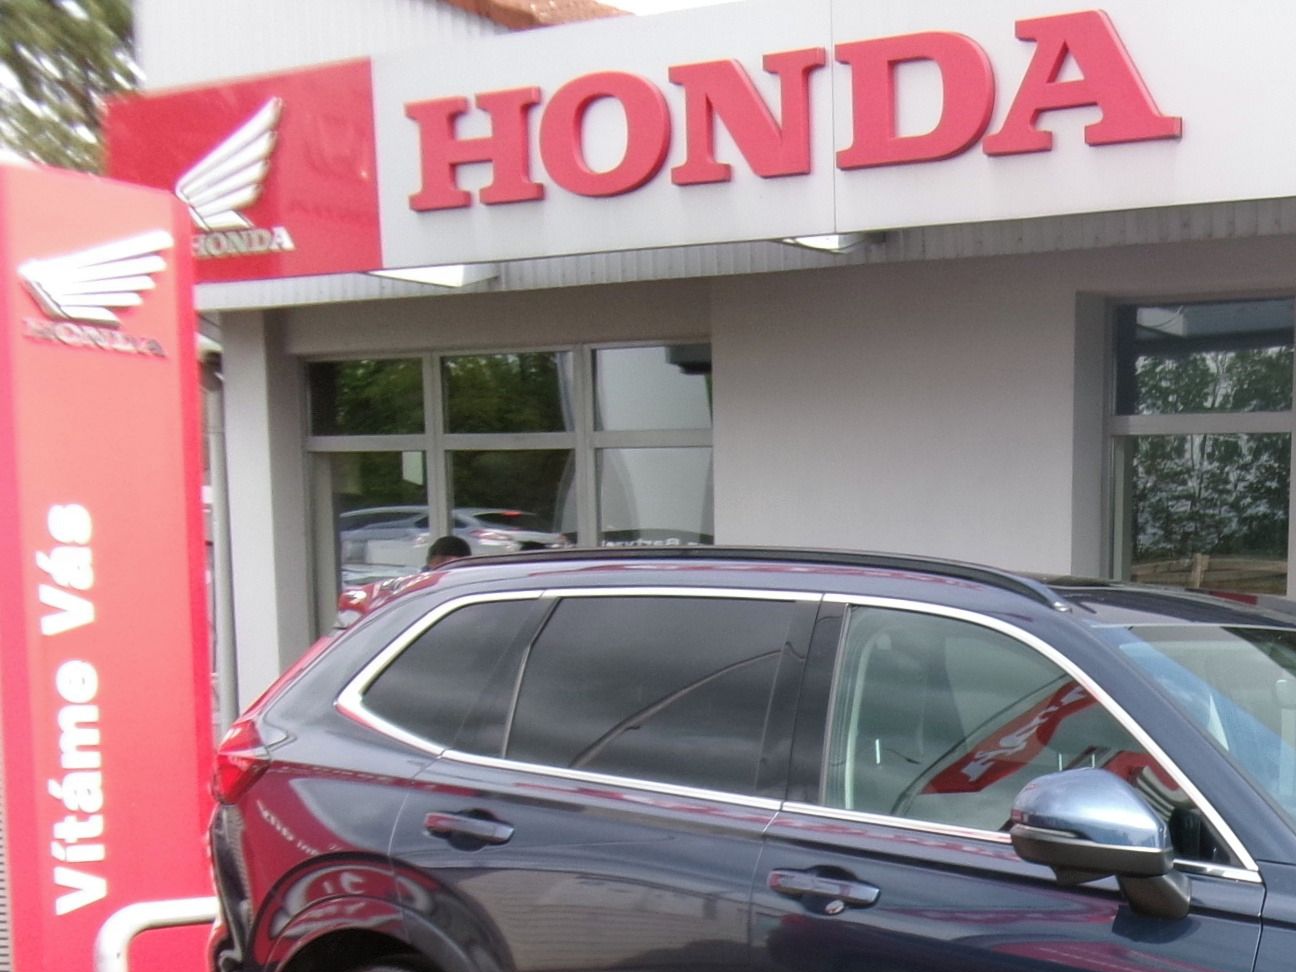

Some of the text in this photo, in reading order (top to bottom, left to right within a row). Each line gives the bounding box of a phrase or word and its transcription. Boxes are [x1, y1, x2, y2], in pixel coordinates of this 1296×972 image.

[406, 9, 1183, 212] HONDA
[23, 317, 167, 358] HONDA
[36, 504, 107, 916] Vítáme Vás
